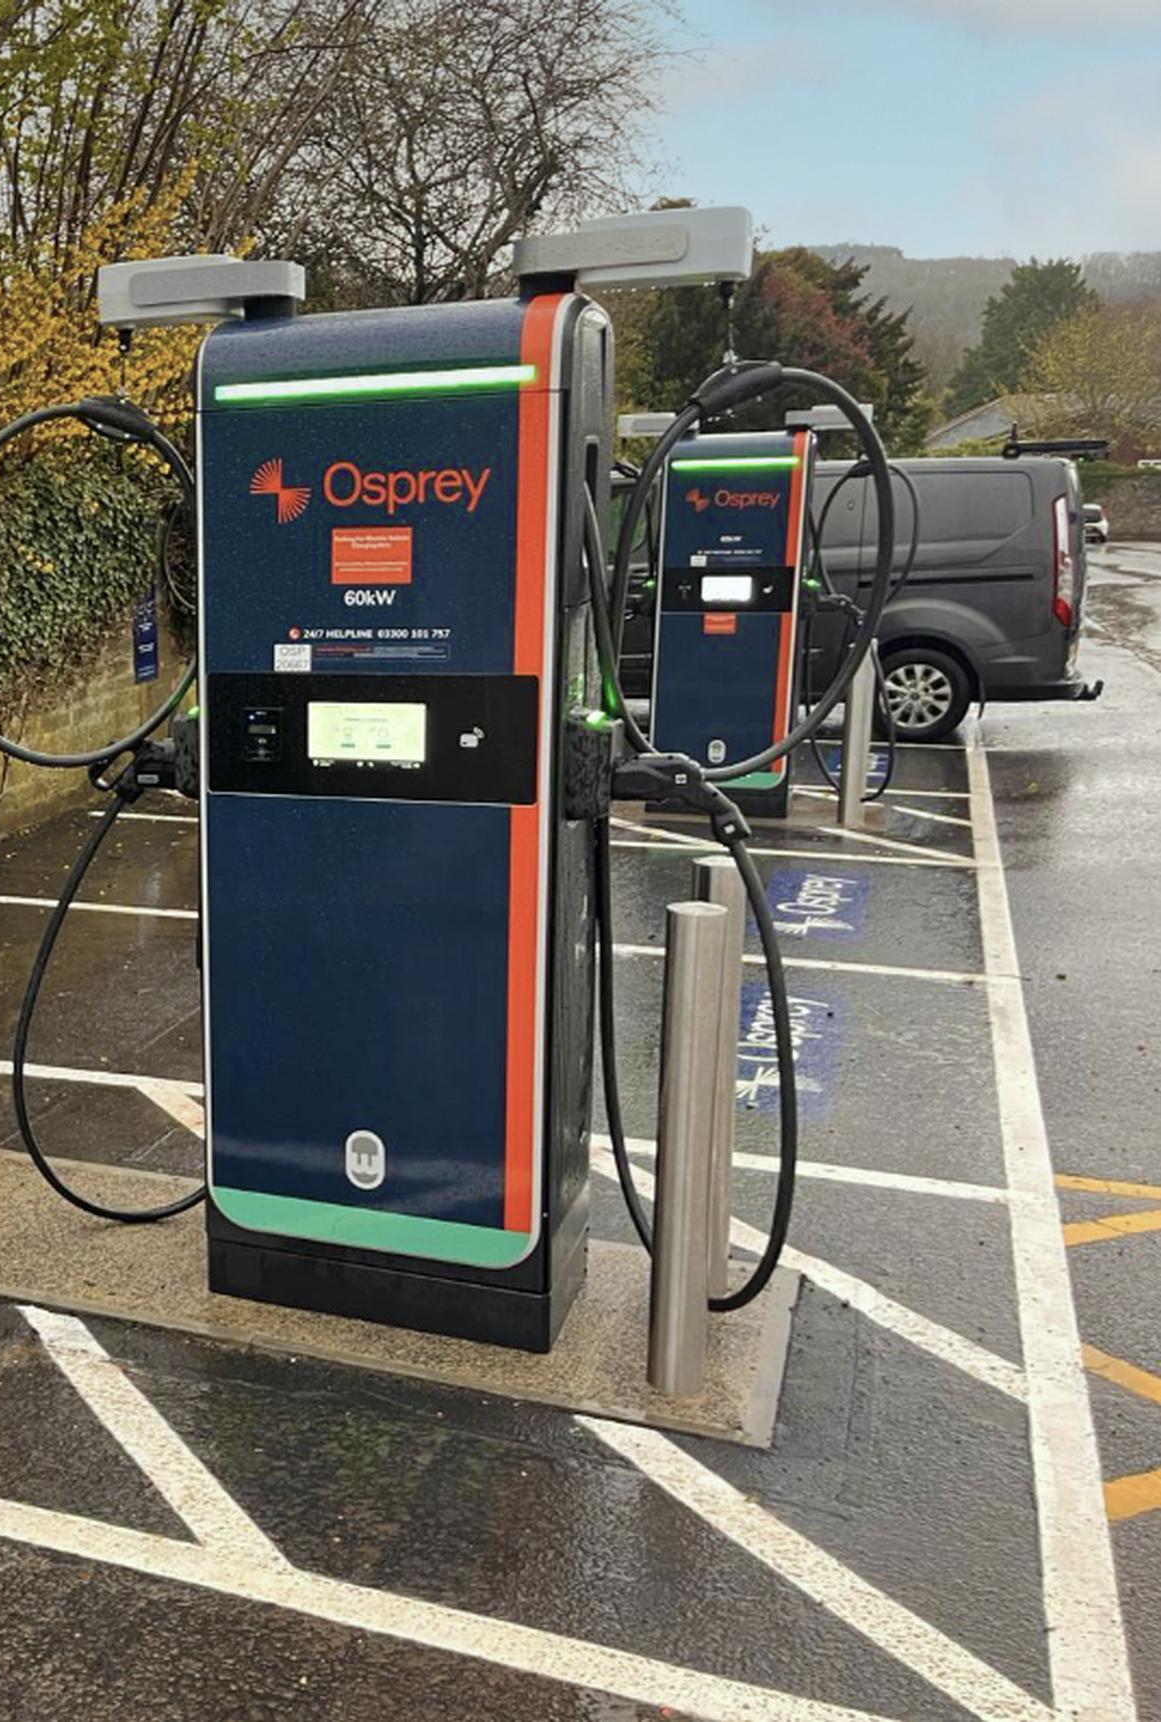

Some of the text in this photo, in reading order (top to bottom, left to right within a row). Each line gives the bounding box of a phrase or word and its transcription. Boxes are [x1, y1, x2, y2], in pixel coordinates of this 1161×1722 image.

[323, 461, 491, 515] Osprey
[714, 489, 781, 512] Osprey
[344, 590, 396, 607] 60kW
[302, 628, 324, 639] 24/7
[326, 628, 373, 639] HELPLINE
[776, 872, 858, 916] Osprey
[736, 990, 830, 1063] Osprey
